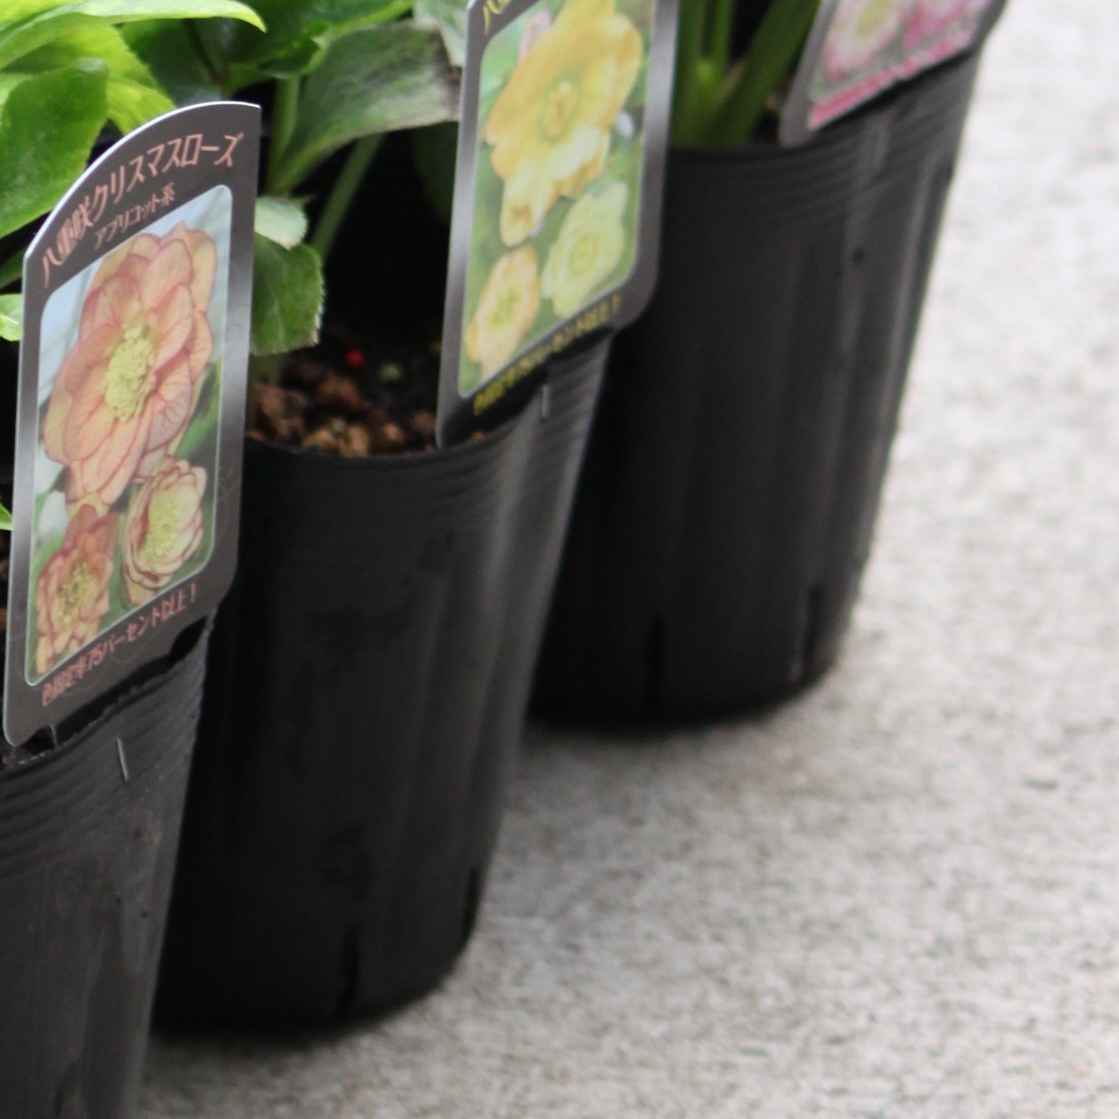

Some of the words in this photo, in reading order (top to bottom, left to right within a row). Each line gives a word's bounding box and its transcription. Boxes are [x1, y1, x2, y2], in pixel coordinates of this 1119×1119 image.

[42, 132, 244, 288] 八重咲クリスマスローズ
[94, 182, 176, 250] アプリコット系
